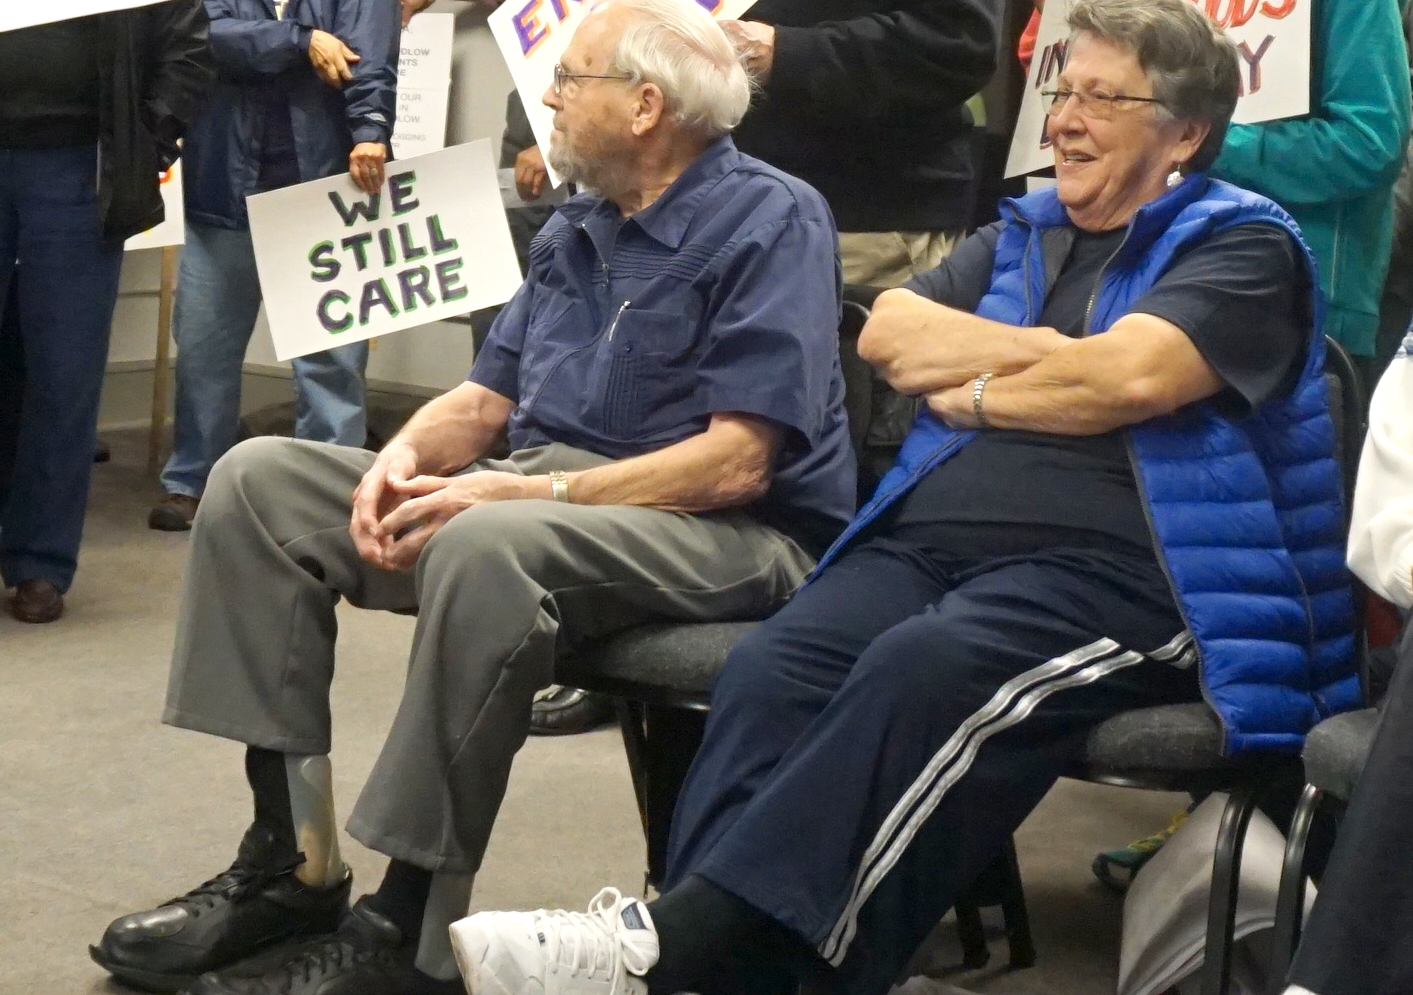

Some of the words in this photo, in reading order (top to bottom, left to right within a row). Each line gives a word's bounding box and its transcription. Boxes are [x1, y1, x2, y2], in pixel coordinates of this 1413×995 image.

[400, 48, 430, 56] DLOW
[397, 115, 420, 123] LOW
[392, 134, 426, 142] OGGING
[328, 170, 420, 227] WE
[308, 214, 458, 283] STILL
[316, 257, 469, 335] CARE
